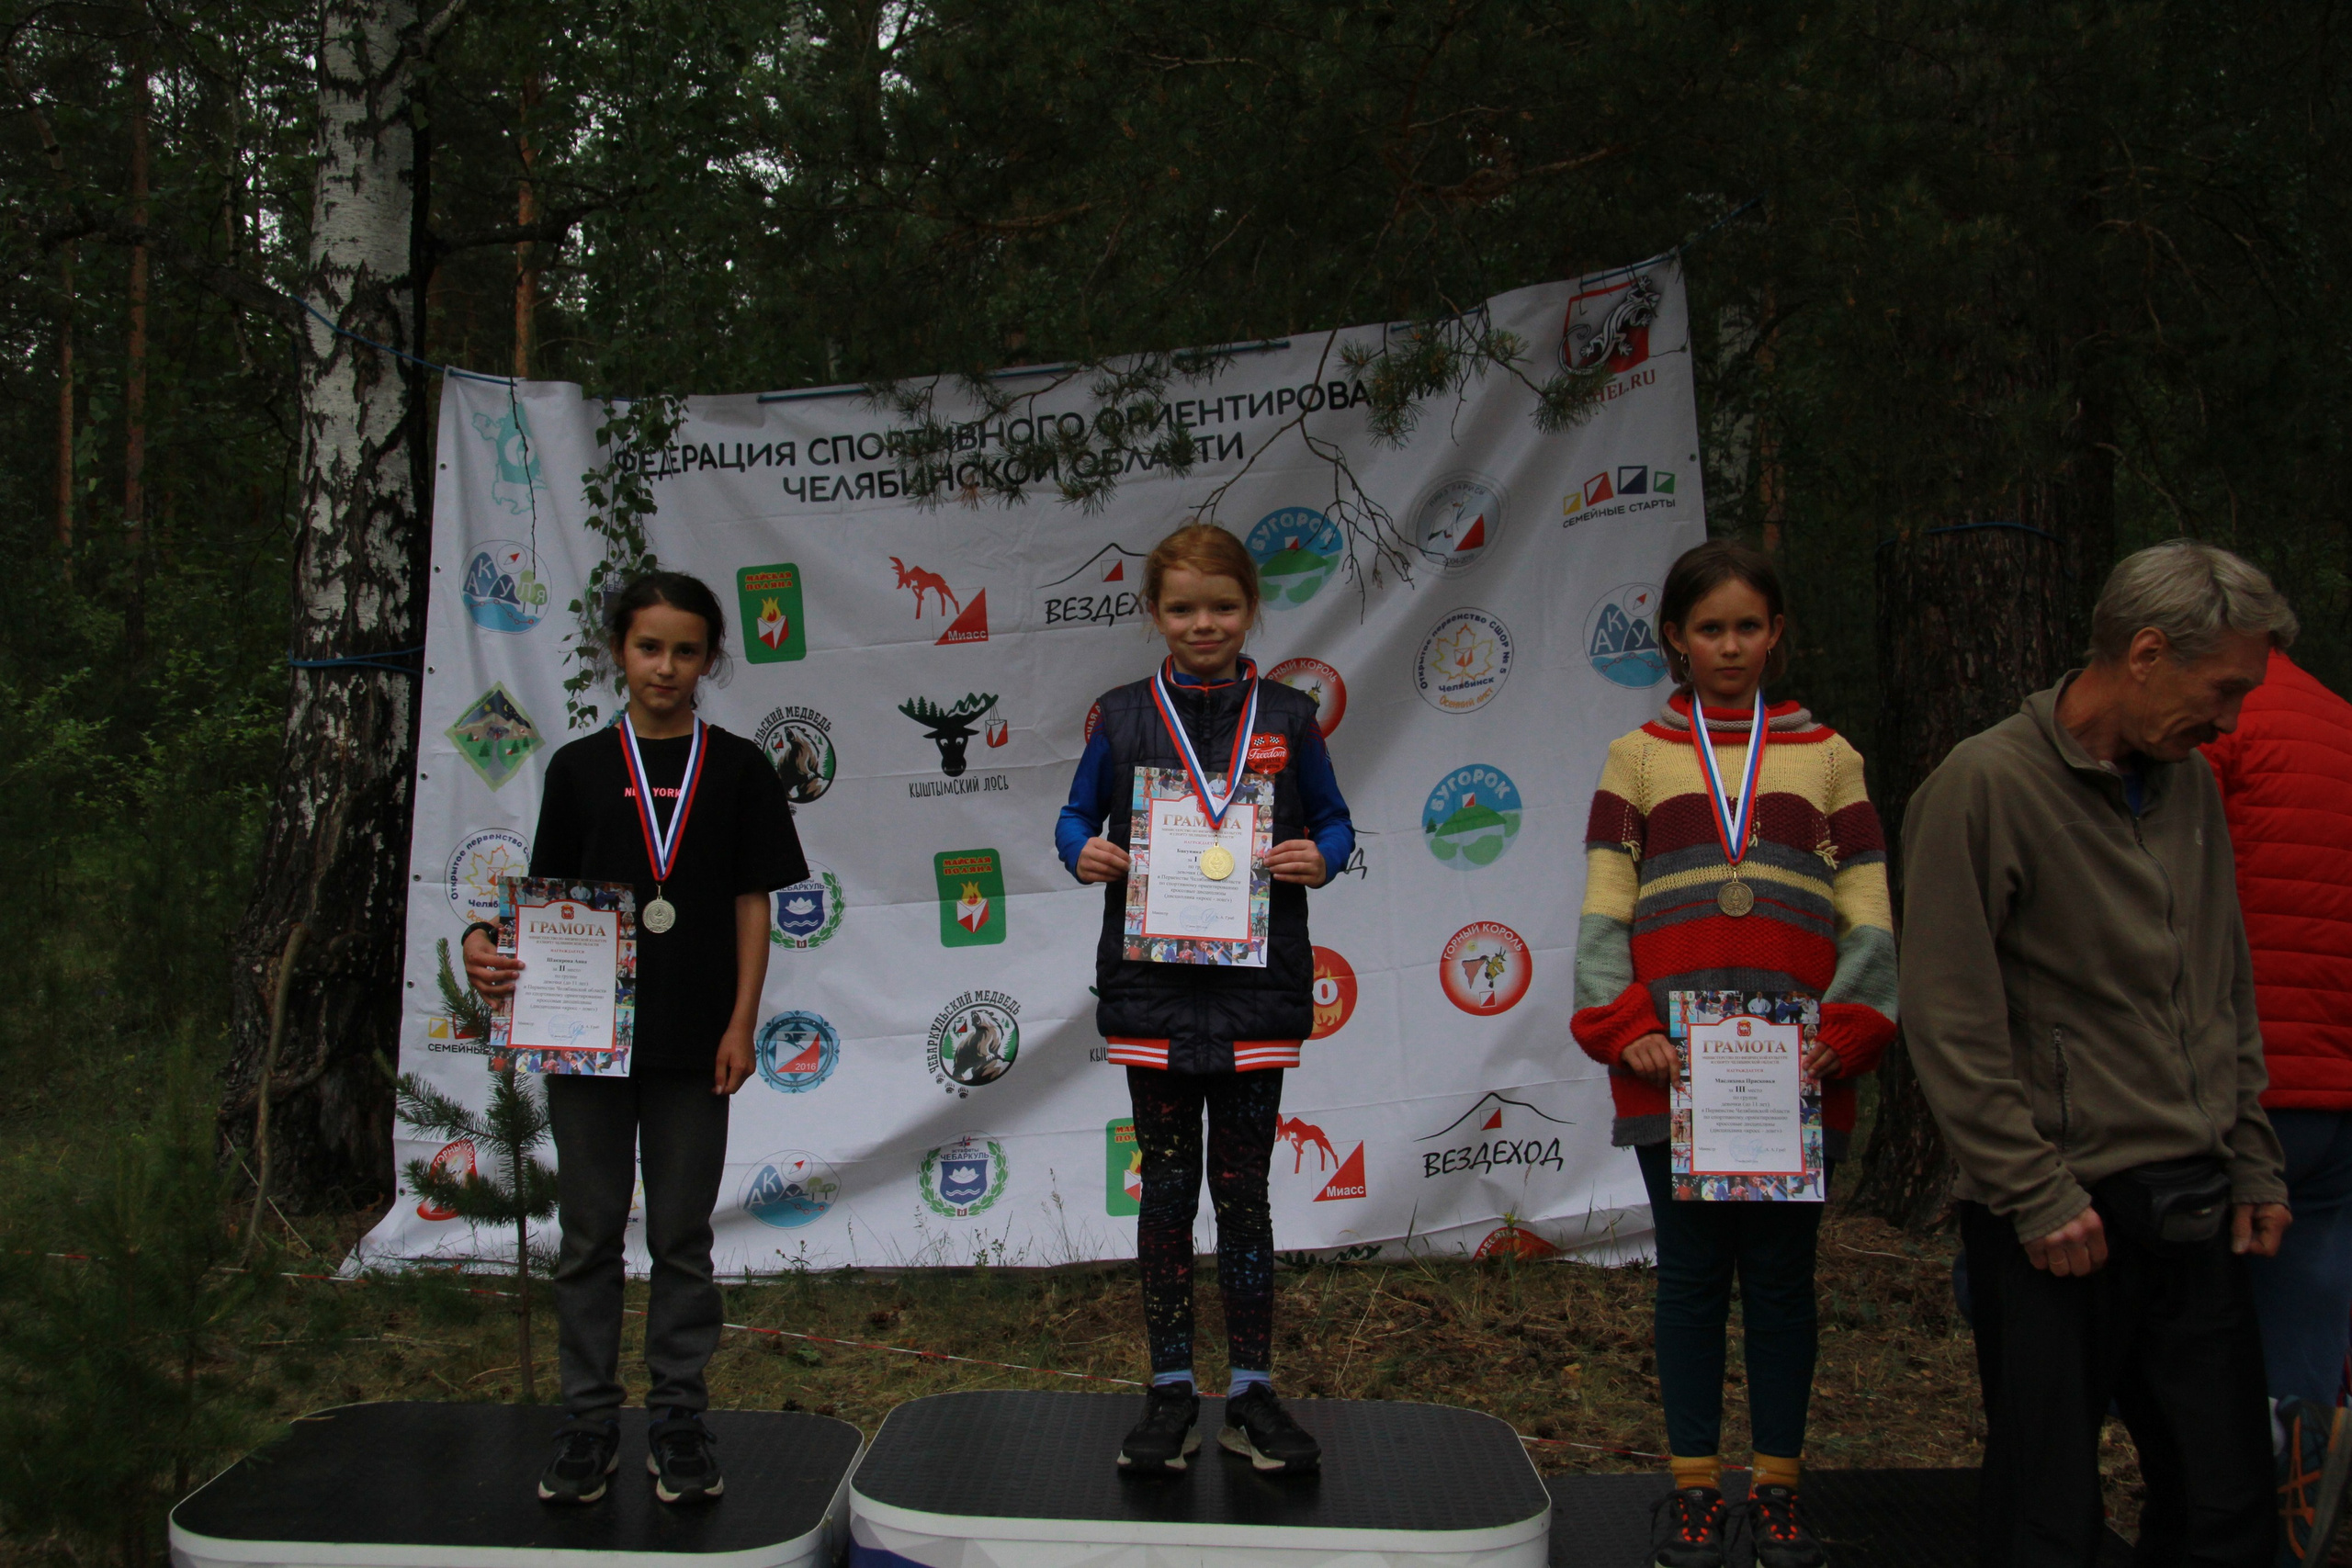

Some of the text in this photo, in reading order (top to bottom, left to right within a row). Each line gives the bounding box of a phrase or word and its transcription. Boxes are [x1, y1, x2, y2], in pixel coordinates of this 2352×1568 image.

[615, 441, 796, 480] ФЕДЕРАЦИЯ
[1095, 369, 1442, 438] ОРИЕНТИРОВА
[1072, 432, 1243, 478] ОБЛАТИ
[1563, 499, 1676, 529] СЕМЕЙНЫЕ СТАРТЫ
[745, 570, 793, 583] МАЙСКАЯ
[745, 581, 793, 591] ПОЛЯНА
[1045, 592, 1144, 626] ВЕЗДЕХ
[947, 630, 987, 641] Миасс
[1418, 638, 1431, 690] Открытое
[1432, 613, 1487, 637] первенство
[1489, 621, 1510, 648] СШОР
[1300, 660, 1339, 682] КОРОЛЬ
[1439, 677, 1495, 693] Челябинск
[785, 706, 832, 732] МЕДВЕДЬ
[1247, 746, 1287, 761] Freedom
[909, 774, 1010, 798] КЫШТЫМСКИЙ ЛОСЬ
[1429, 768, 1511, 812] БУГОРОК
[1162, 814, 1242, 829] ГРАМТА
[450, 833, 523, 900] Открытое первенство
[943, 856, 991, 866] МАЙСКАЯ
[944, 865, 992, 875] ПОЛЯНА
[469, 899, 499, 908] Челяб
[528, 920, 606, 937] ГРАМОТА
[1443, 923, 1524, 960] ГОРНЫЙ КОРОЛЬ
[926, 990, 1022, 1074] ЧЕБАРКУЛЬСКИЙ МЕДВЕДЬ
[1702, 1040, 1787, 1054] ГРАМОТА
[795, 1062, 817, 1071] 2016
[434, 1142, 461, 1168] ГОРНЫ
[940, 1152, 989, 1160] ЧЕБАРКУЛЬ
[1421, 1137, 1564, 1179] ВЕЗДЕХОД
[1326, 1185, 1364, 1198] Миасс
